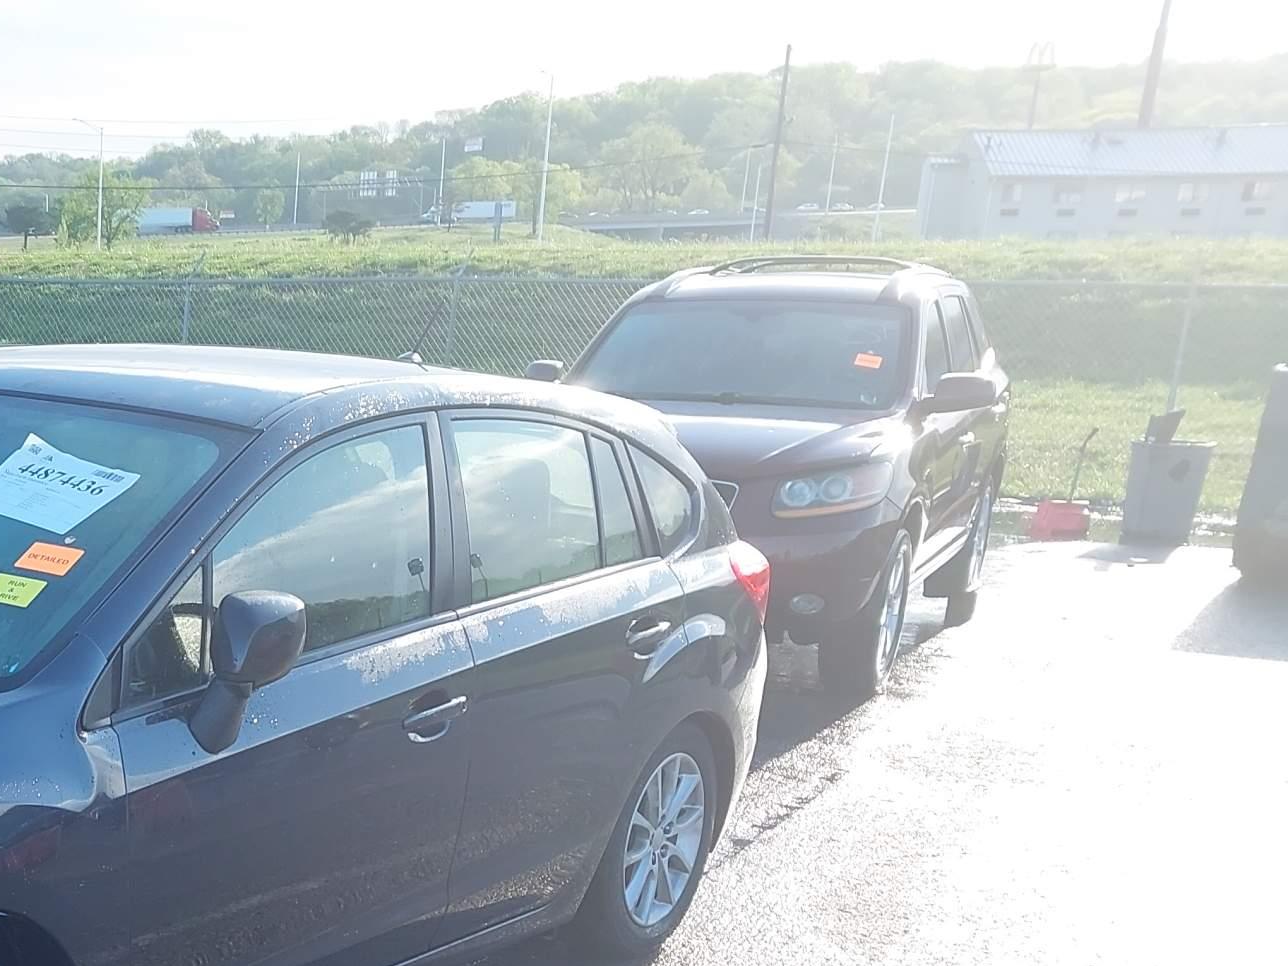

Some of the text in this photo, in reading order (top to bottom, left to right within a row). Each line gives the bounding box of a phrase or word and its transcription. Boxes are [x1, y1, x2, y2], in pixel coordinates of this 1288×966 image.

[18, 463, 110, 496] 44874436
[27, 552, 70, 566] DETAILED
[7, 580, 28, 588] RUN
